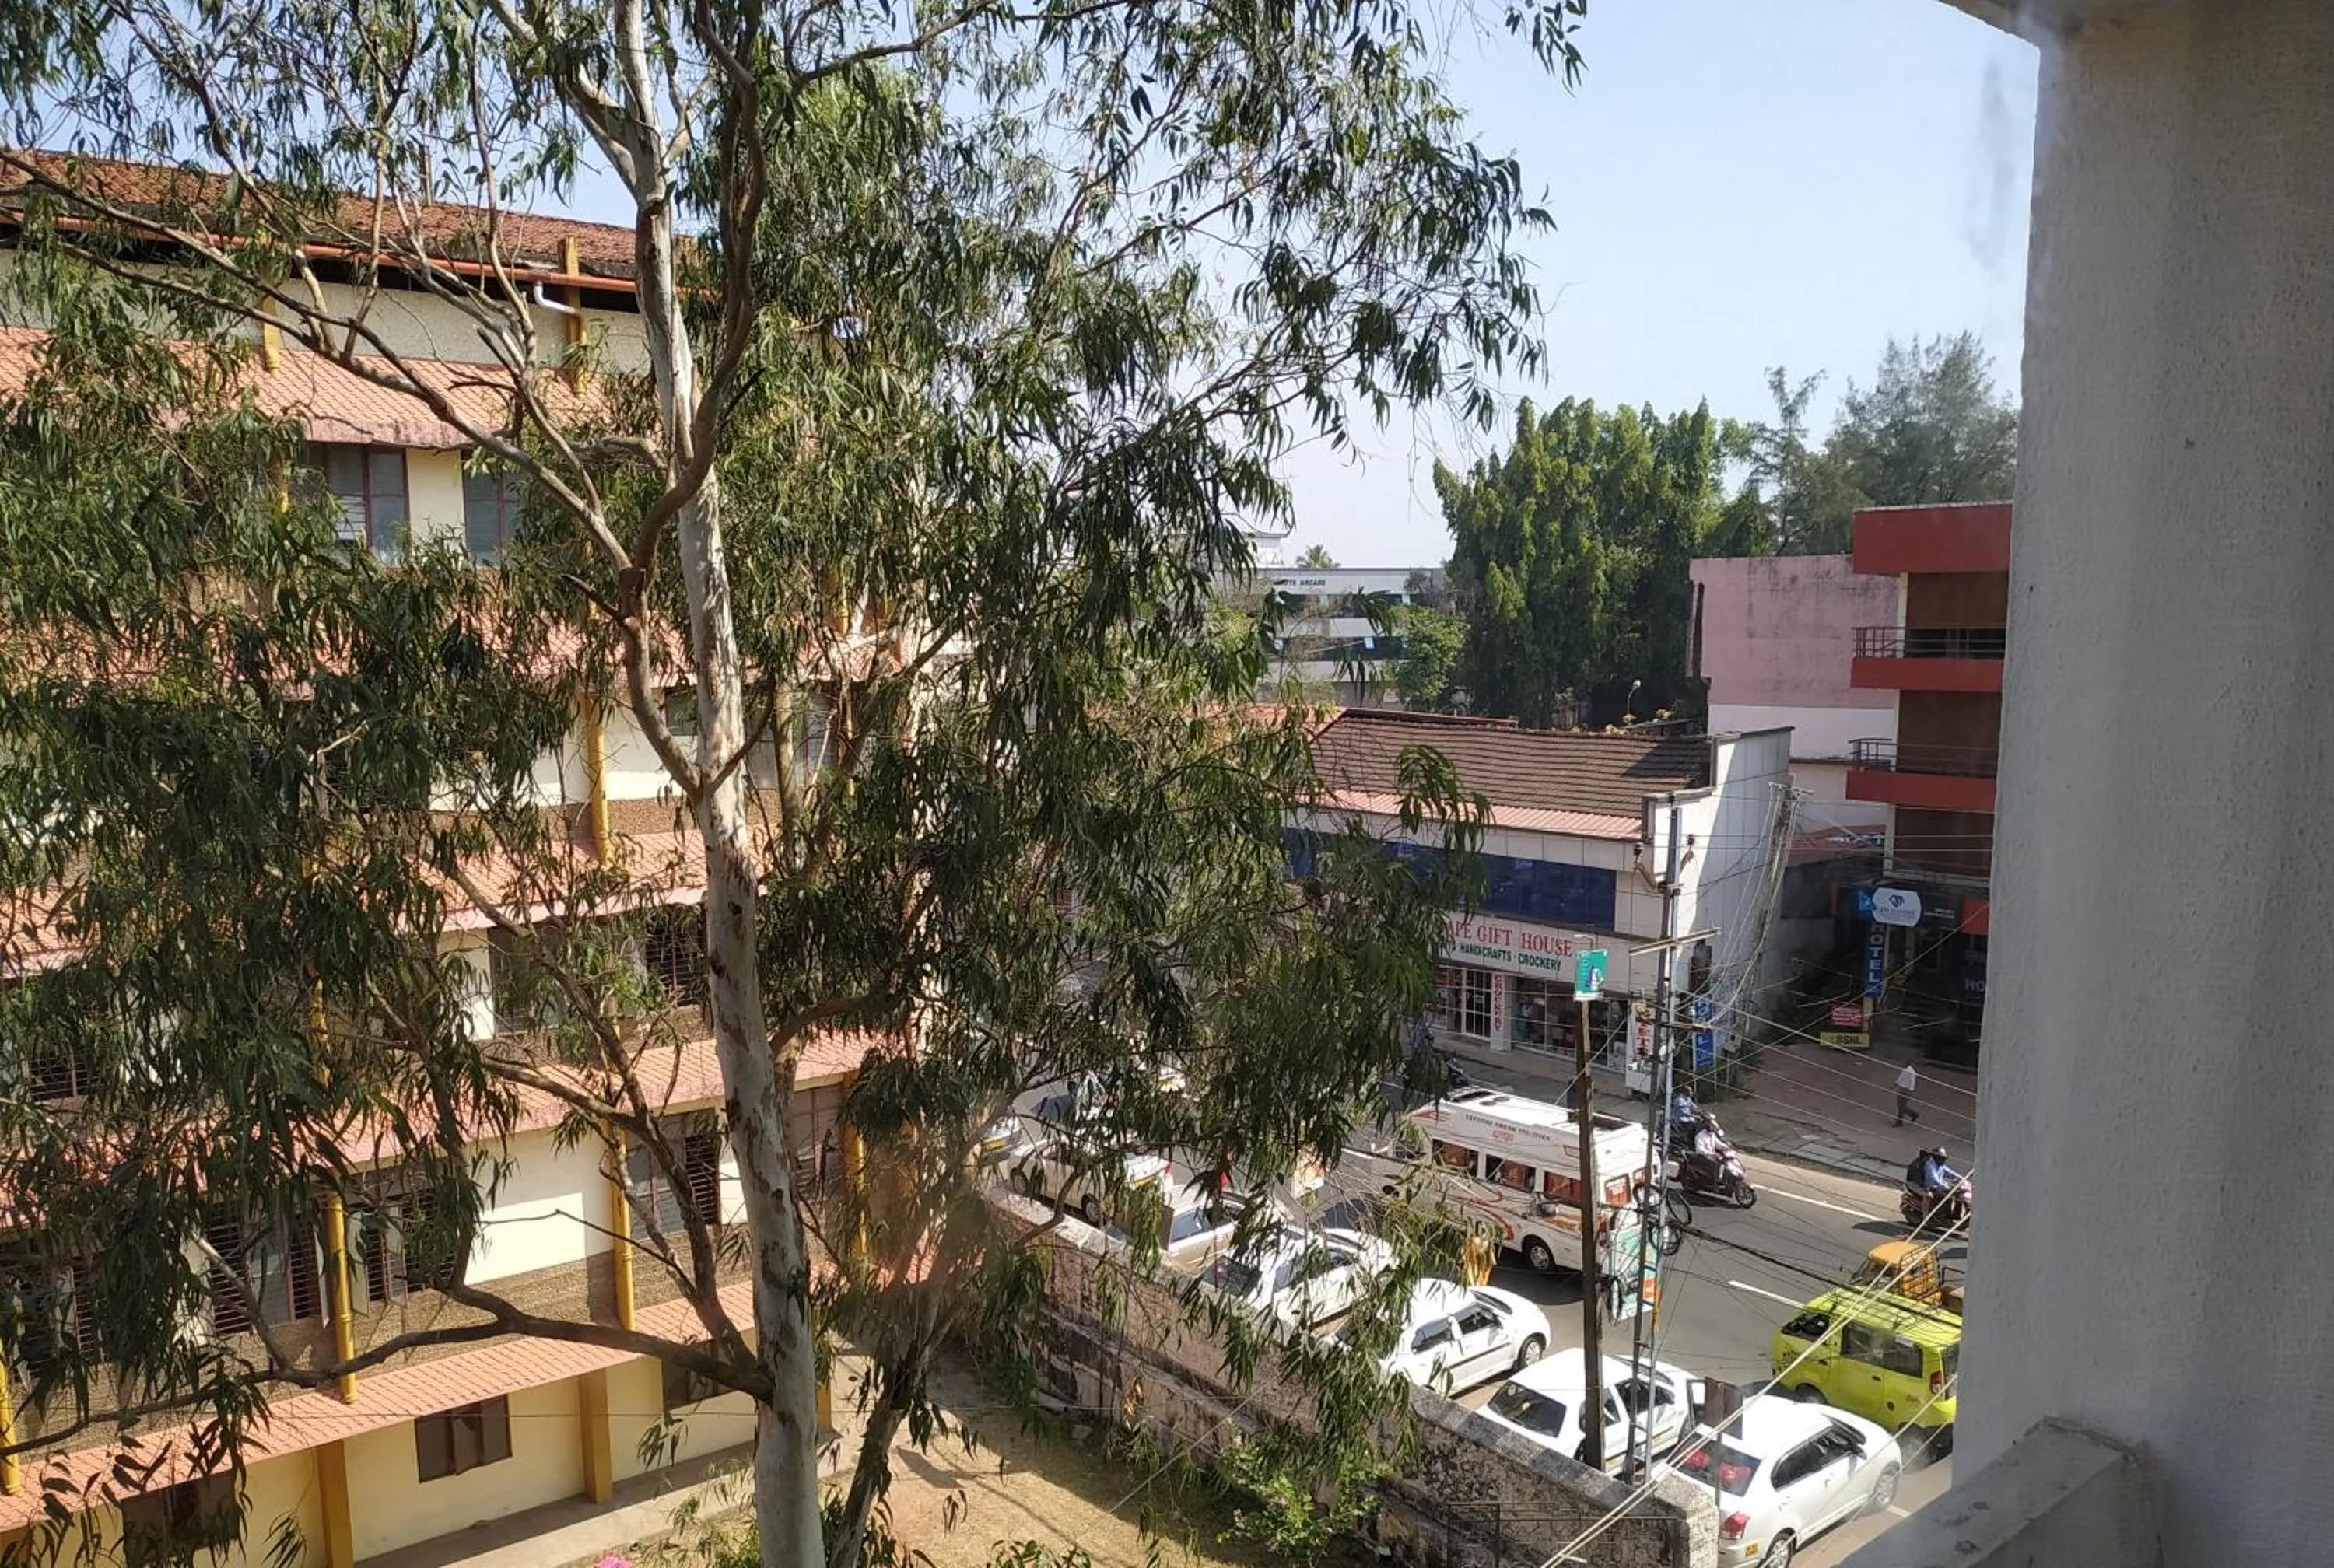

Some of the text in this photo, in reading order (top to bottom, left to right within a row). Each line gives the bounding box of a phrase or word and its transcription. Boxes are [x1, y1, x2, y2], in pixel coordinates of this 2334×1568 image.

[1477, 925, 1512, 946] GIFT
[1520, 933, 1572, 957] HOUSE
[1518, 953, 1561, 971] CROCKERY
